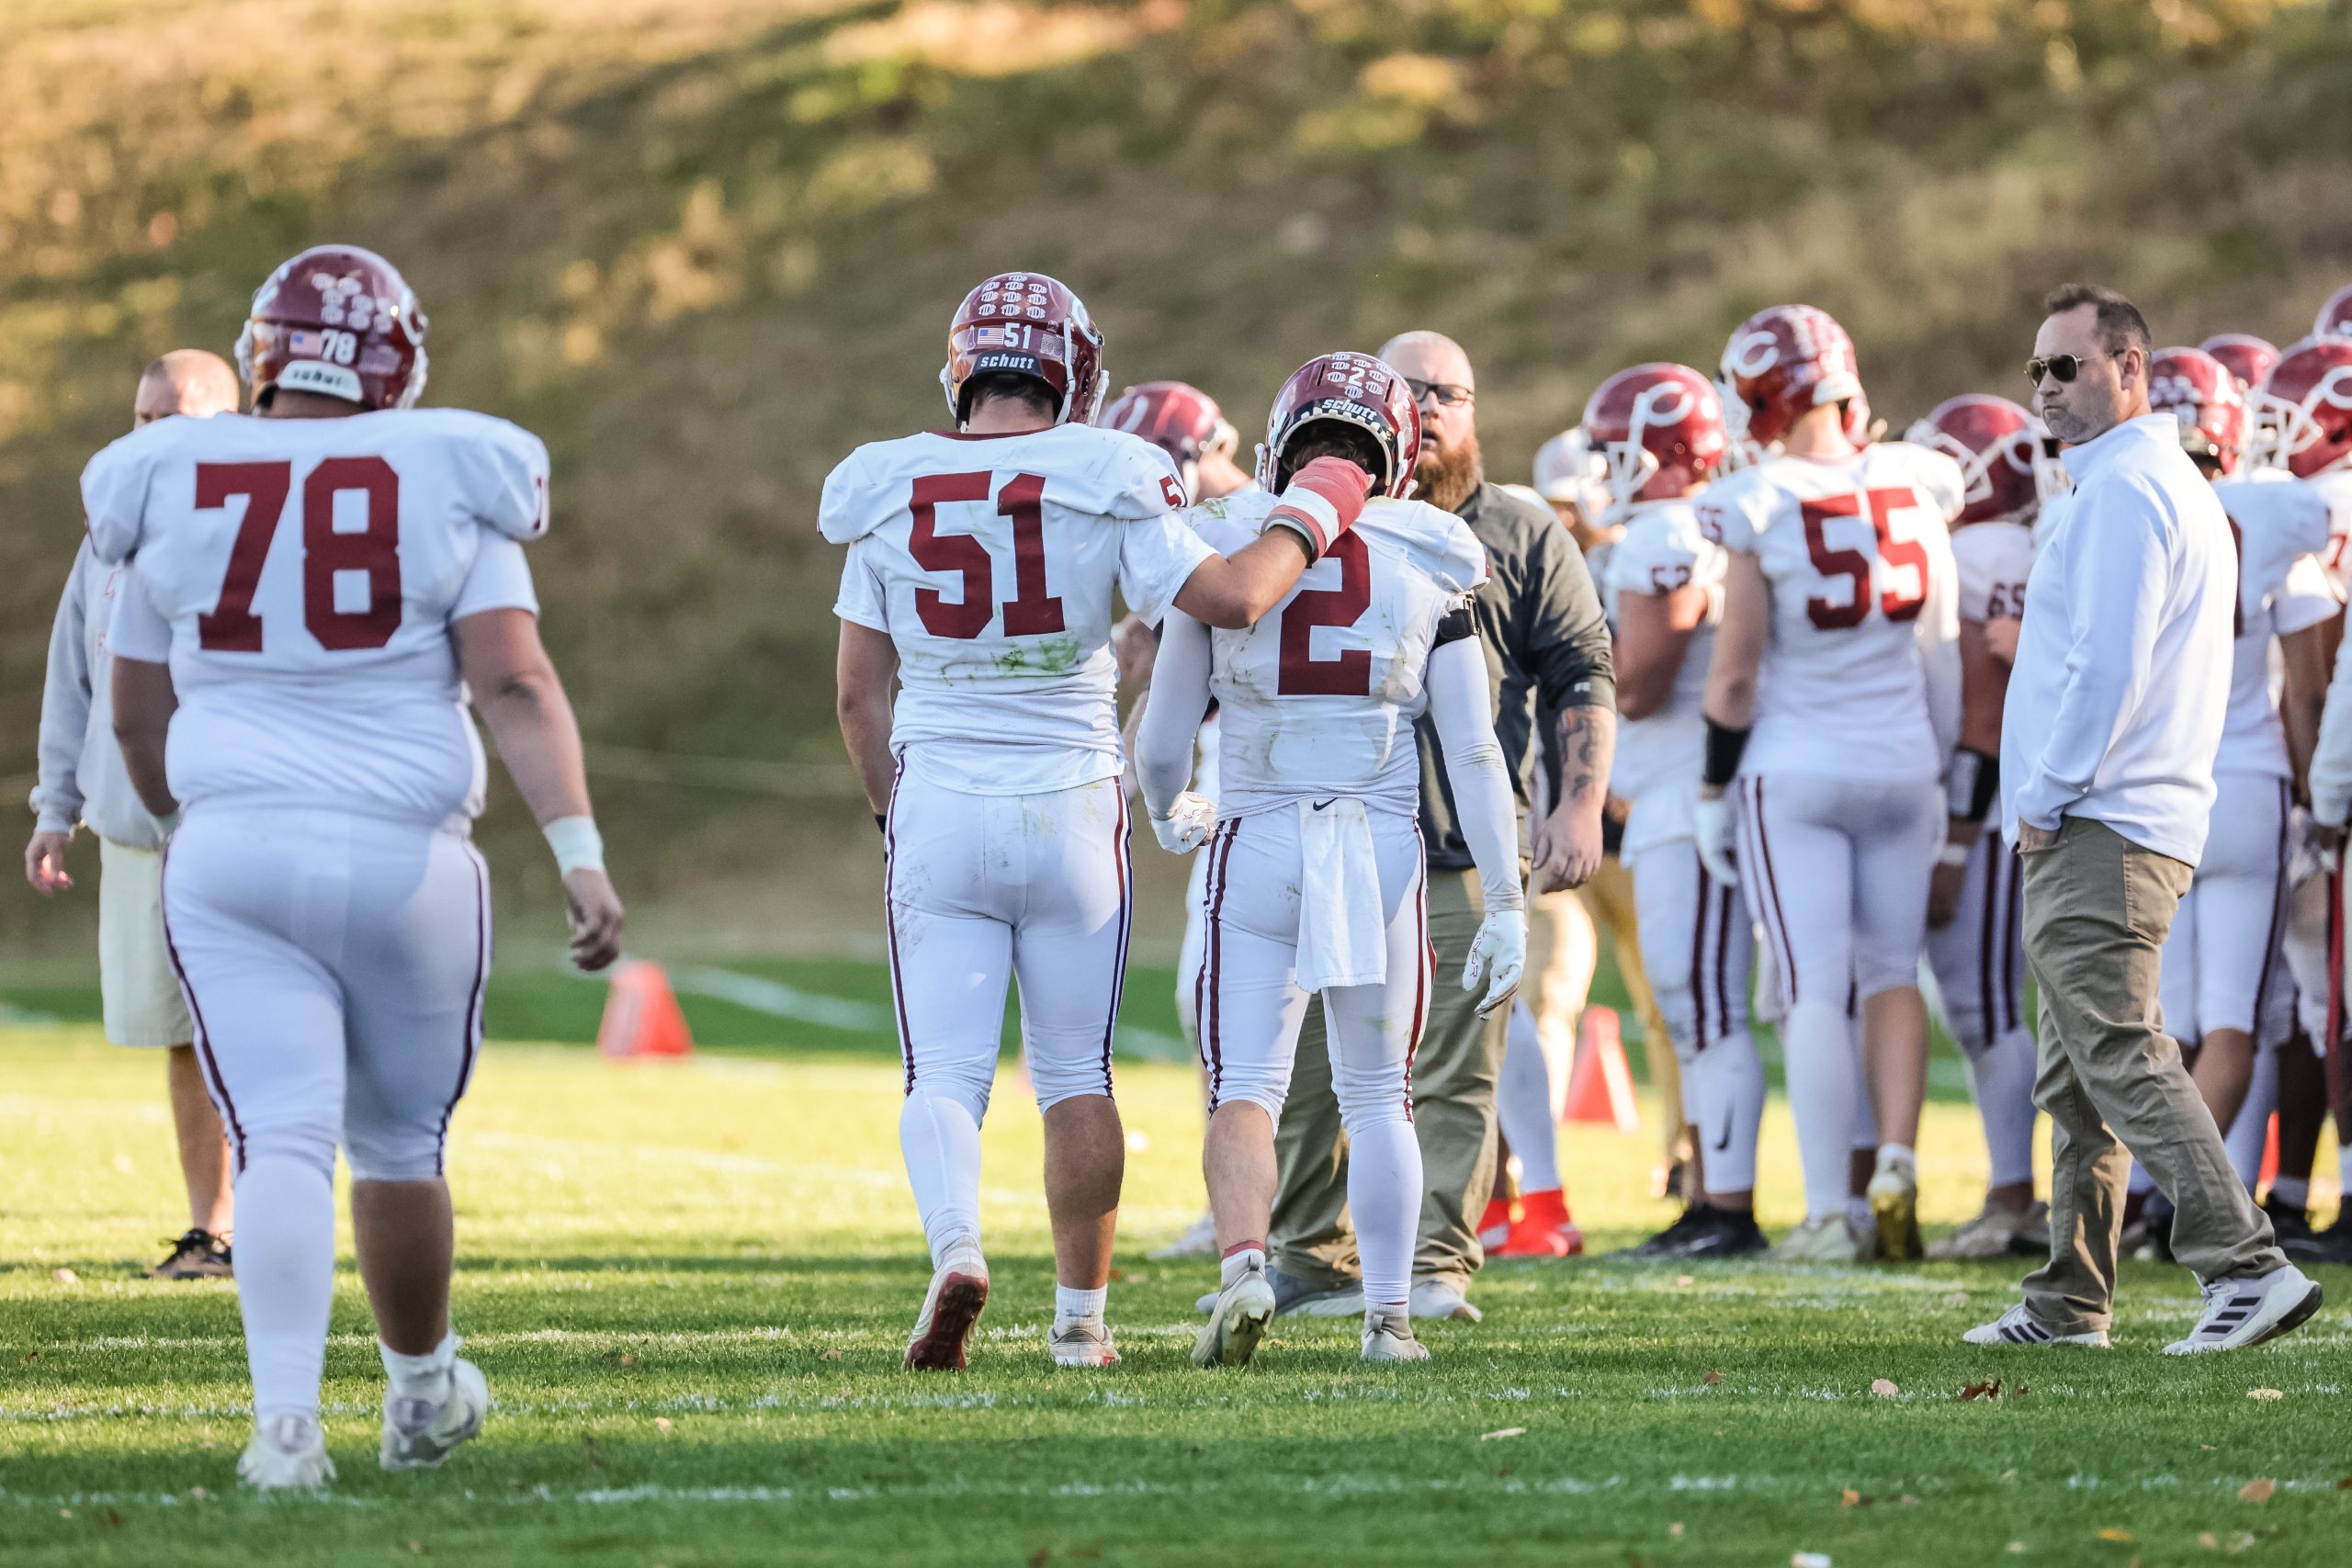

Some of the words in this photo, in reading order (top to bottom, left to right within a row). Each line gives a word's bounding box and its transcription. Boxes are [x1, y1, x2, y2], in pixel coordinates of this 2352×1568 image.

[322, 329, 357, 365] 78
[1003, 321, 1033, 350] 51
[980, 354, 1035, 369] schutt
[1348, 367, 1365, 387] 2
[1321, 399, 1379, 421] schutt
[195, 456, 401, 652] 78
[908, 469, 1066, 639] 51
[1800, 487, 1928, 631] 55
[1277, 526, 1372, 696] 2
